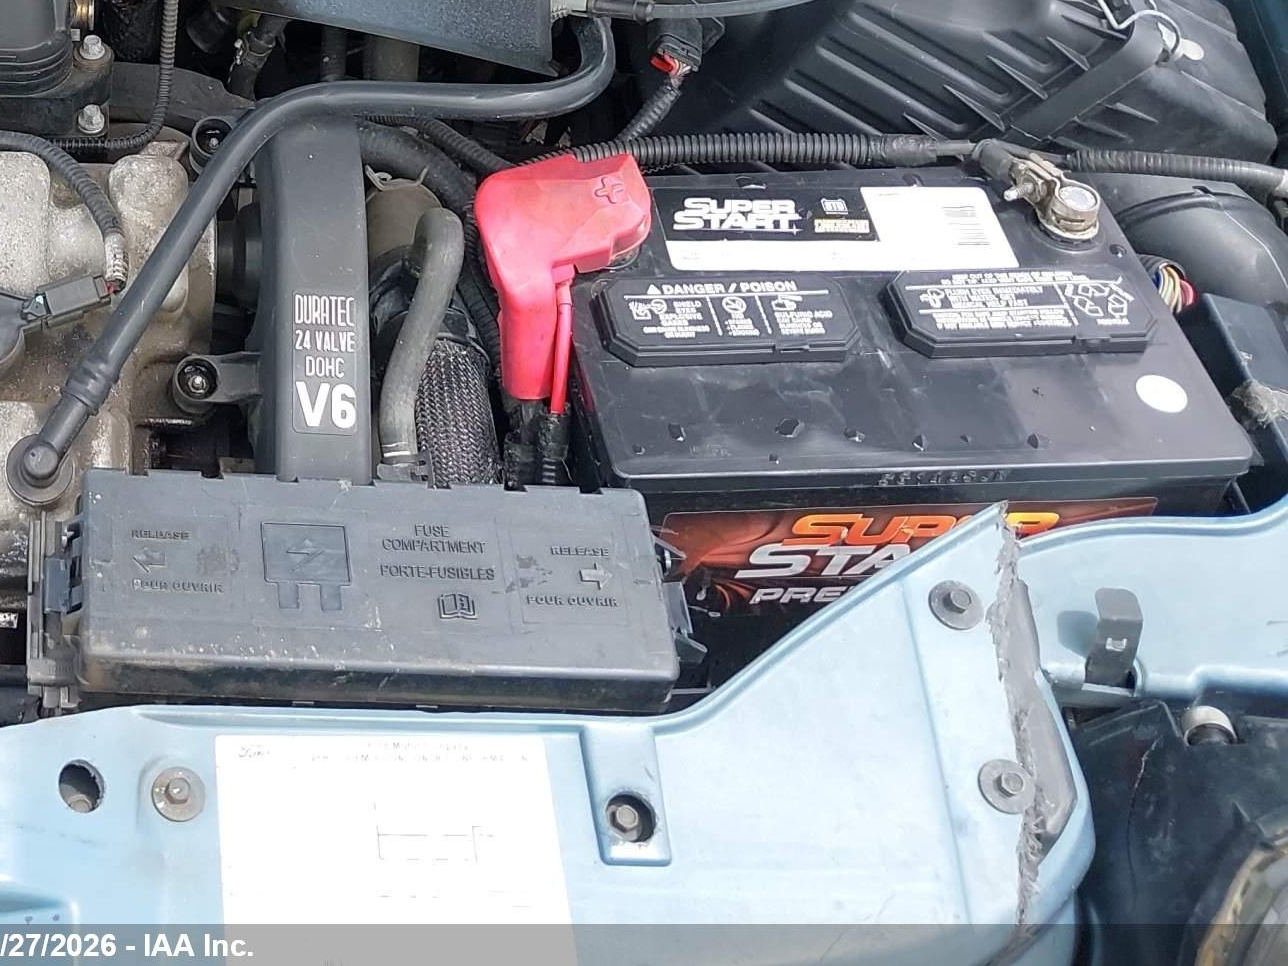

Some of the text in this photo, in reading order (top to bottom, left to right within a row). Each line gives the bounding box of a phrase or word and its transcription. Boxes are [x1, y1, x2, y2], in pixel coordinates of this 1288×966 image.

[683, 197, 797, 215] SUPER
[673, 212, 802, 232] START
[661, 283, 726, 295] DANGER
[739, 281, 797, 293] POISON
[295, 294, 355, 327] DURATEC
[295, 329, 356, 352] 24 VALVE
[305, 355, 345, 378] DOHC
[295, 380, 357, 429] V6
[132, 529, 190, 540] RELEASE
[414, 524, 450, 538] FUSE
[783, 512, 1060, 545] SUPR
[381, 538, 486, 555] COMPARTMENT
[550, 545, 610, 557] RELEASE
[380, 564, 496, 581] PORTE-FUSIBLES
[132, 579, 224, 594] POUR OUVRIR
[526, 594, 620, 608] POUR OUVRIR
